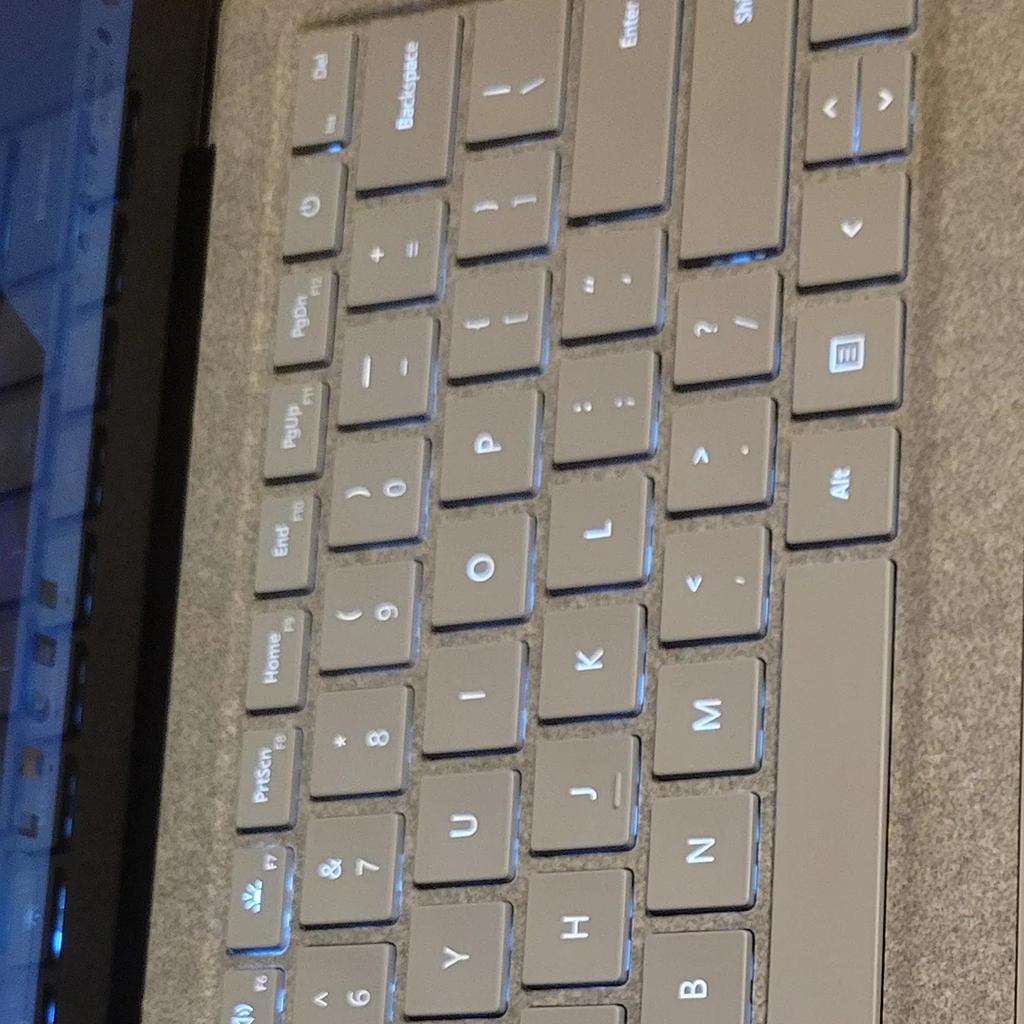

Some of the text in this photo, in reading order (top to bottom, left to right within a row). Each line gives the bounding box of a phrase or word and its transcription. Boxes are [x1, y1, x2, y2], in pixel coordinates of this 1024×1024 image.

[619, 0, 640, 49] Enter
[312, 53, 329, 80] Del
[395, 41, 421, 131] Backspace
[290, 294, 311, 339] PgDn
[694, 323, 718, 337] ?
[281, 405, 303, 449] PgUp
[474, 434, 502, 454] P
[383, 479, 407, 498] 0
[830, 468, 851, 500] Alt
[271, 525, 290, 557] End
[583, 521, 612, 540] L
[466, 555, 495, 582] O
[375, 604, 399, 621] 9
[283, 616, 296, 633] F9
[263, 632, 281, 684] Home
[575, 649, 604, 671] K
[692, 699, 722, 731] M
[273, 734, 287, 751] F8
[366, 729, 390, 747] 8
[253, 747, 272, 803] PrtScn
[569, 787, 597, 801] J
[449, 814, 478, 838] U
[685, 837, 716, 864] N
[264, 854, 278, 871] F7
[319, 859, 342, 880] &
[355, 858, 380, 876] 7
[561, 915, 590, 940] H
[443, 947, 470, 969] Y
[254, 975, 268, 992] F6
[678, 979, 708, 1000] B
[347, 989, 371, 1007] 6
